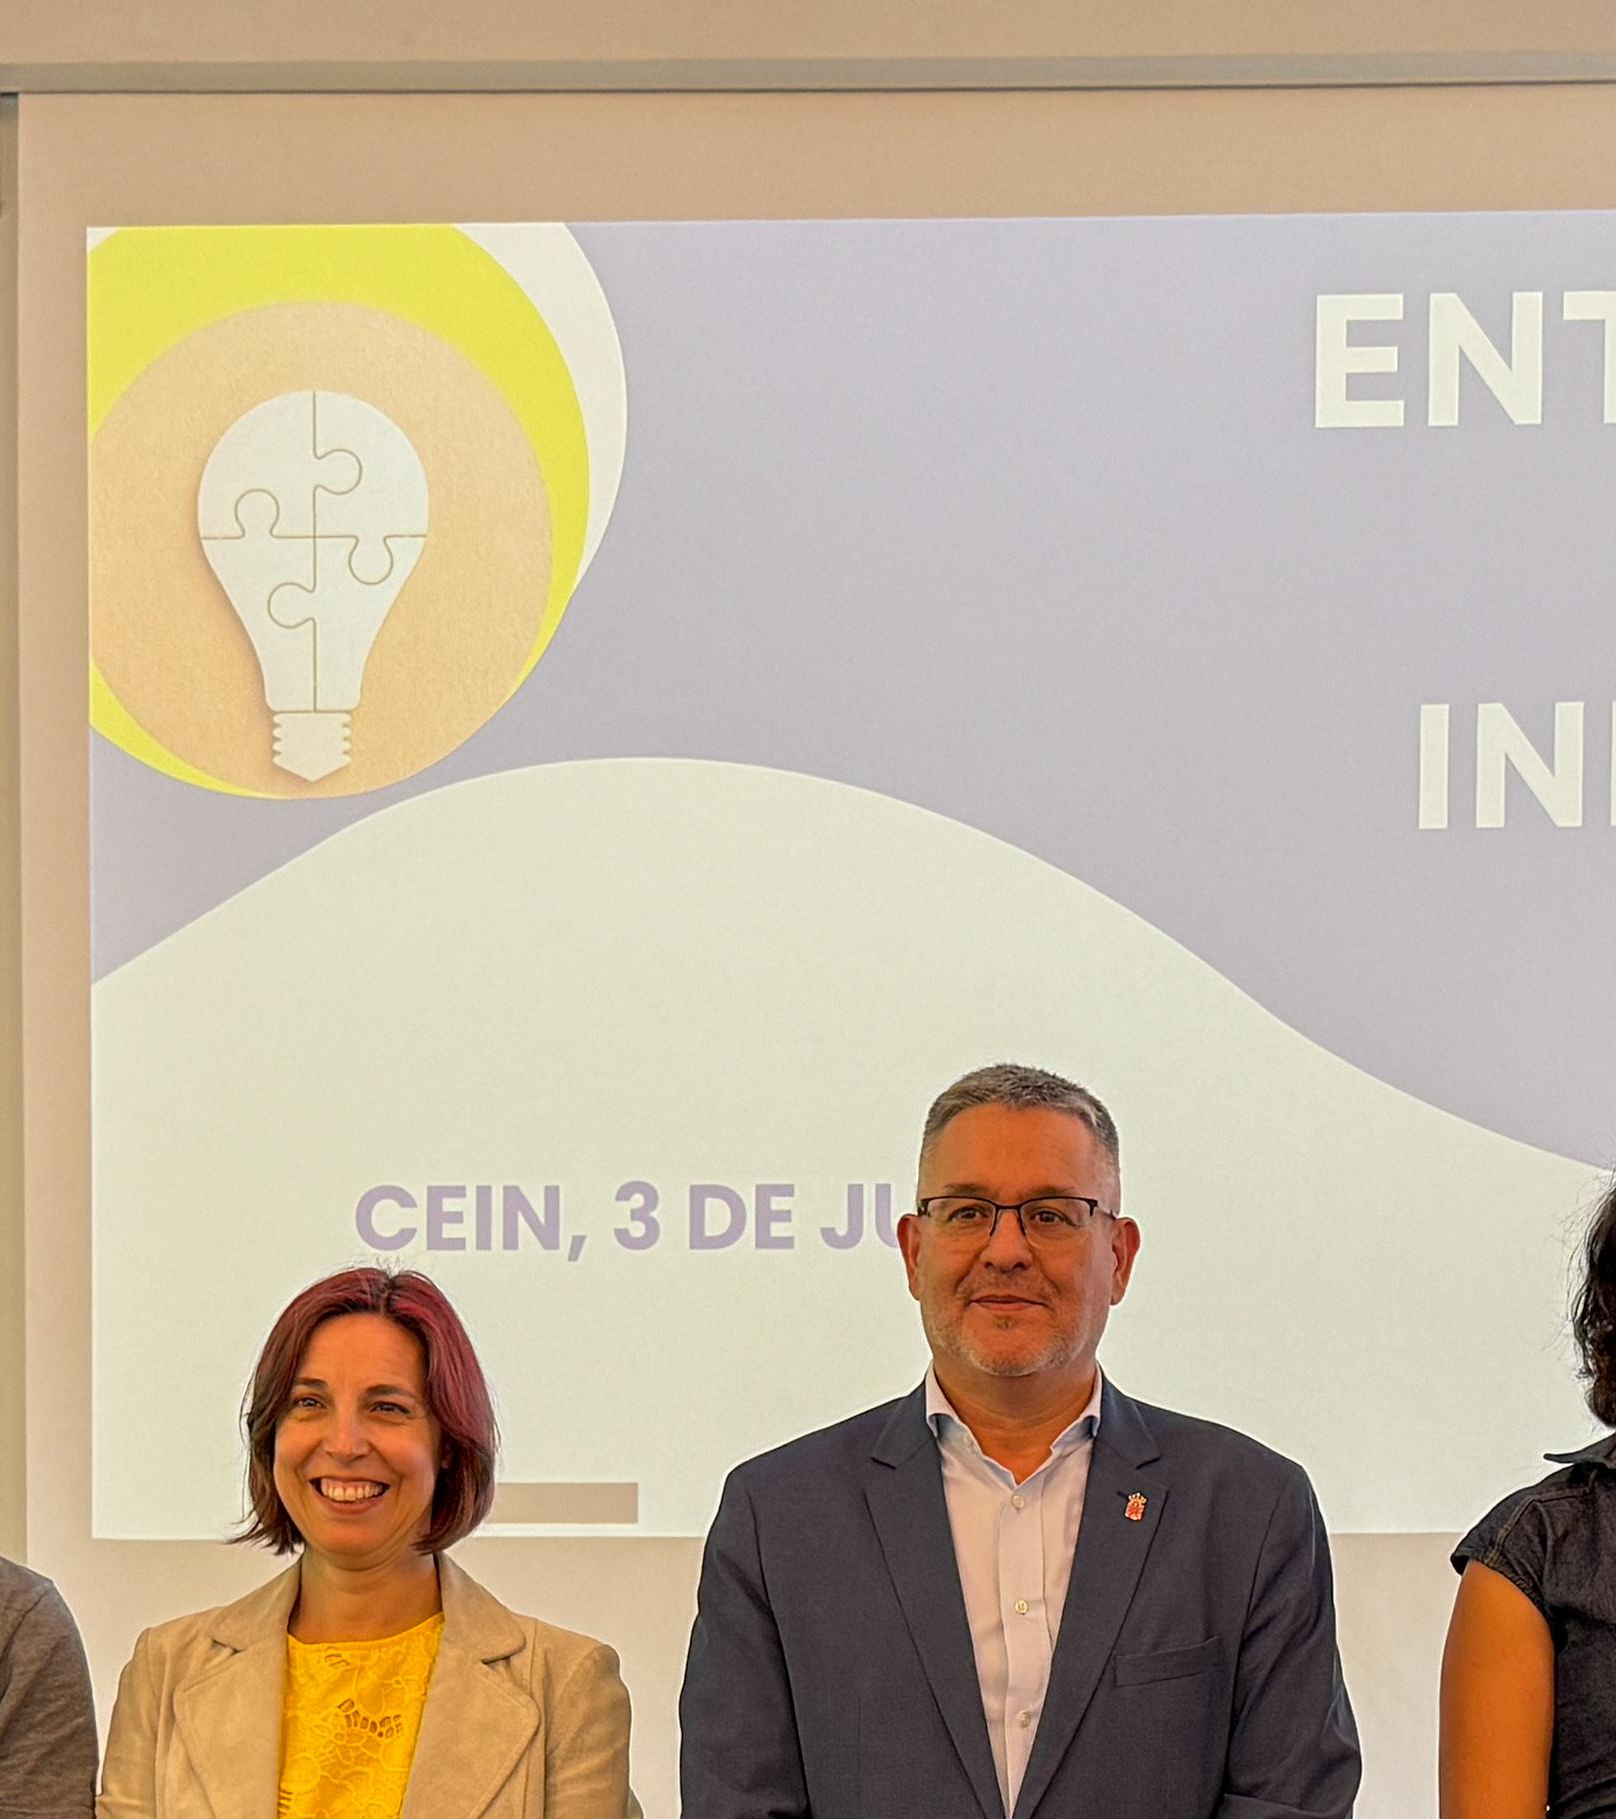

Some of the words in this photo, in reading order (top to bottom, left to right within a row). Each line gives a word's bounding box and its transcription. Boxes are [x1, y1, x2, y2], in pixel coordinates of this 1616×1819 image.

[355, 1185, 586, 1263] CEIN,
[613, 1181, 660, 1251] 3
[689, 1183, 796, 1251] DE
